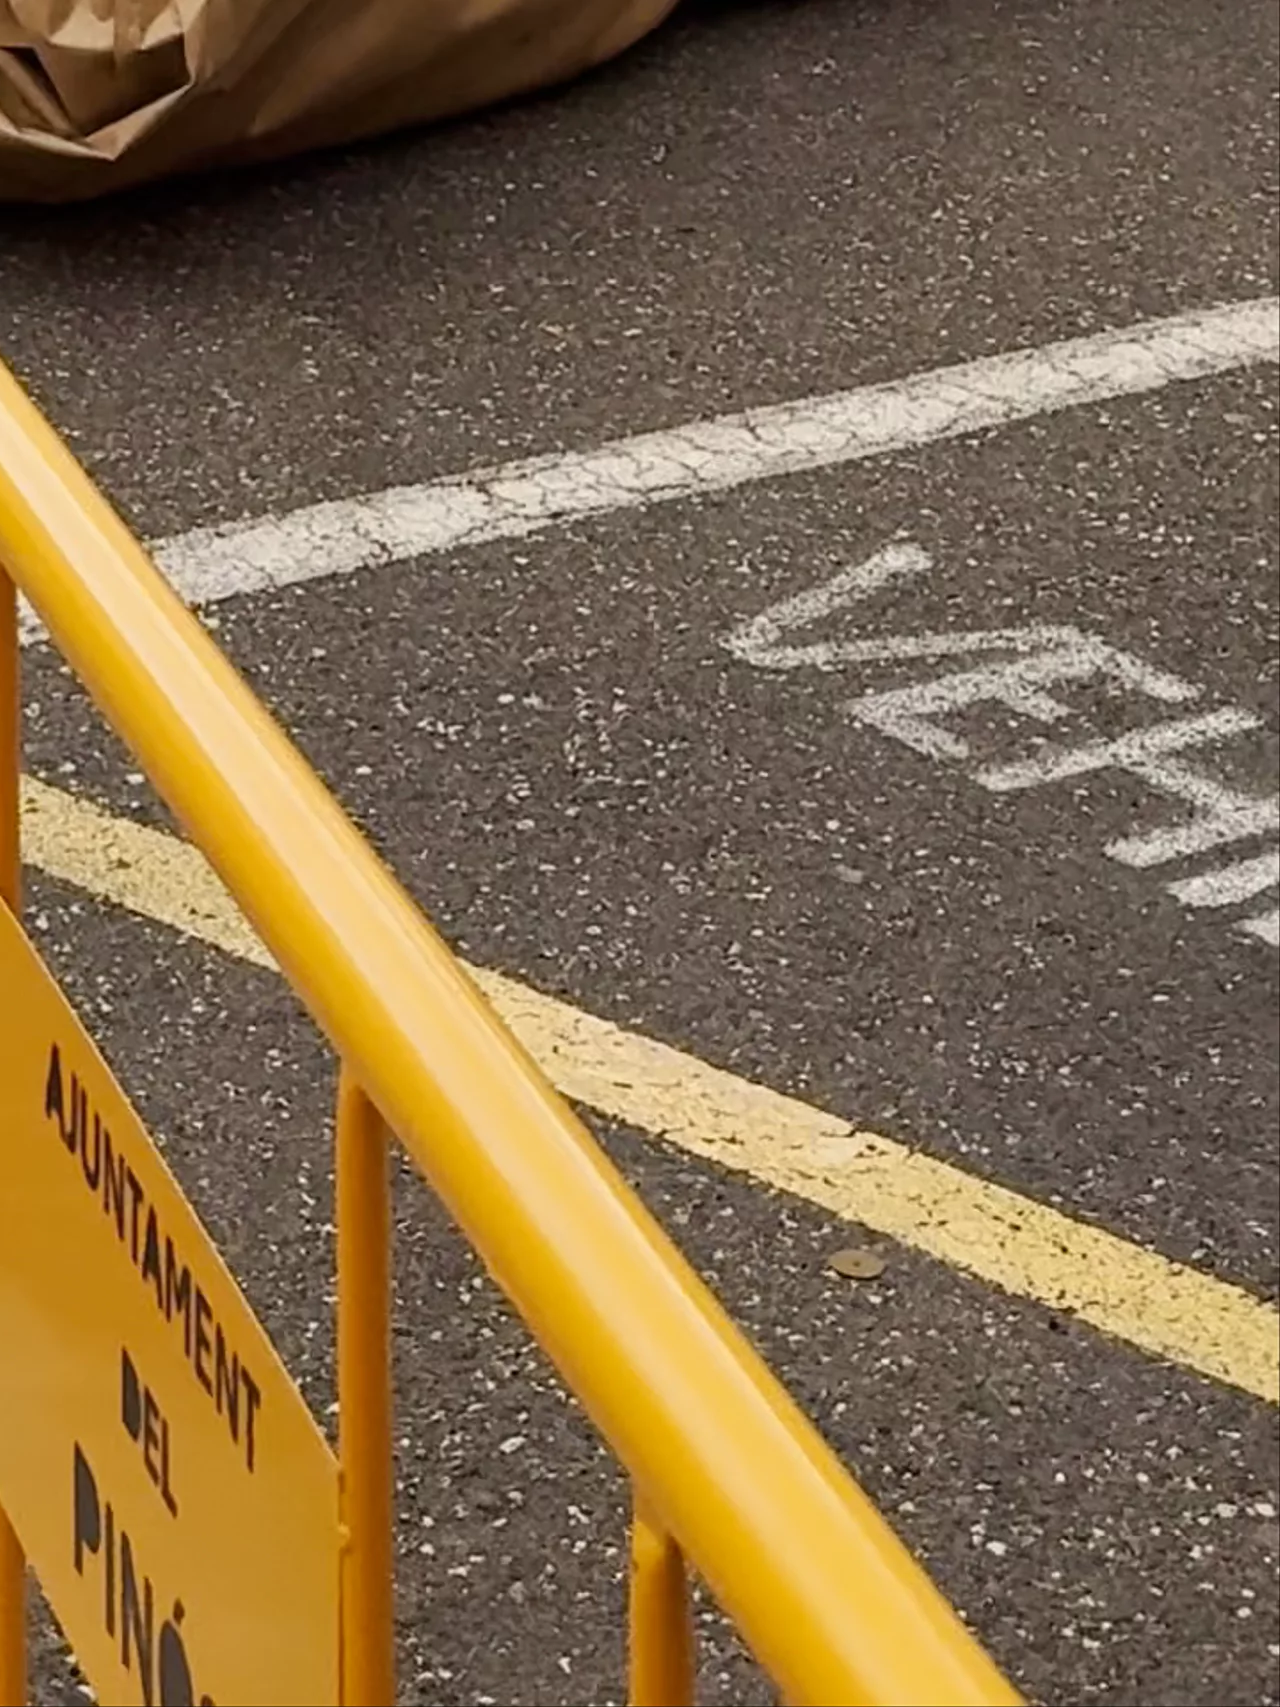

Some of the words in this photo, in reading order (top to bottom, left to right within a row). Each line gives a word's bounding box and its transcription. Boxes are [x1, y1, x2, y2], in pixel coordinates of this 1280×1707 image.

[718, 535, 1280, 948] VEH
[44, 1041, 263, 1475] AJUNTAMENT
[72, 1439, 218, 1707] PINÓ
[120, 1345, 179, 1520] DEL
